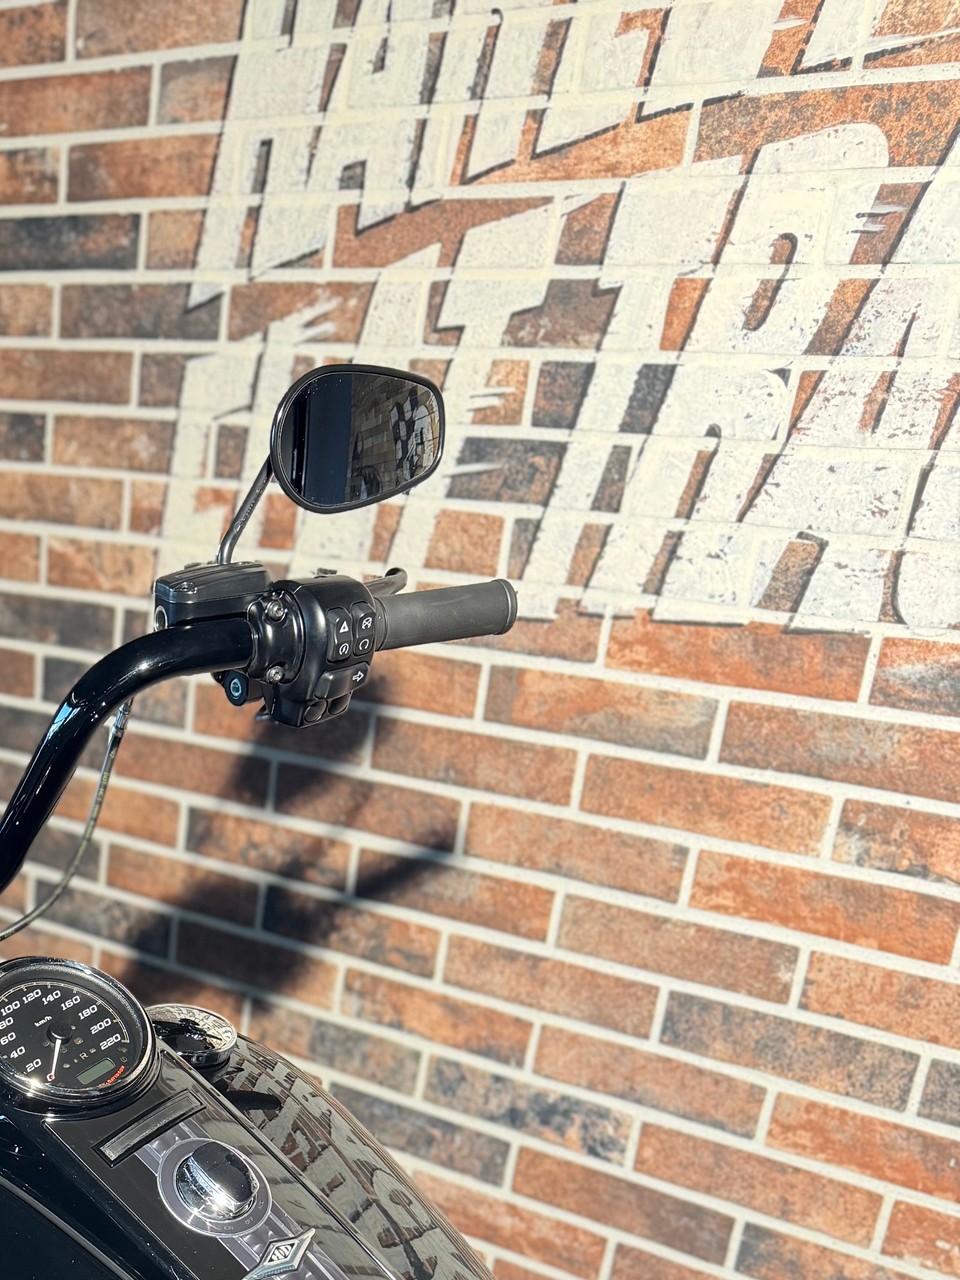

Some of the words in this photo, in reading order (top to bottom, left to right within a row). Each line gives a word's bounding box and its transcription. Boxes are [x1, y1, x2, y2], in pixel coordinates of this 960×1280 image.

[22, 988, 42, 1004] 120
[42, 990, 62, 1005] 140
[60, 995, 81, 1010] 160
[0, 1000, 21, 1016] 100
[78, 1004, 98, 1020] 180
[34, 1015, 52, 1027] km/h
[90, 1018, 112, 1034] 200
[0, 1032, 16, 1046] 60
[99, 1033, 122, 1050] 220
[10, 1046, 26, 1060] 40
[26, 1058, 42, 1073] 20
